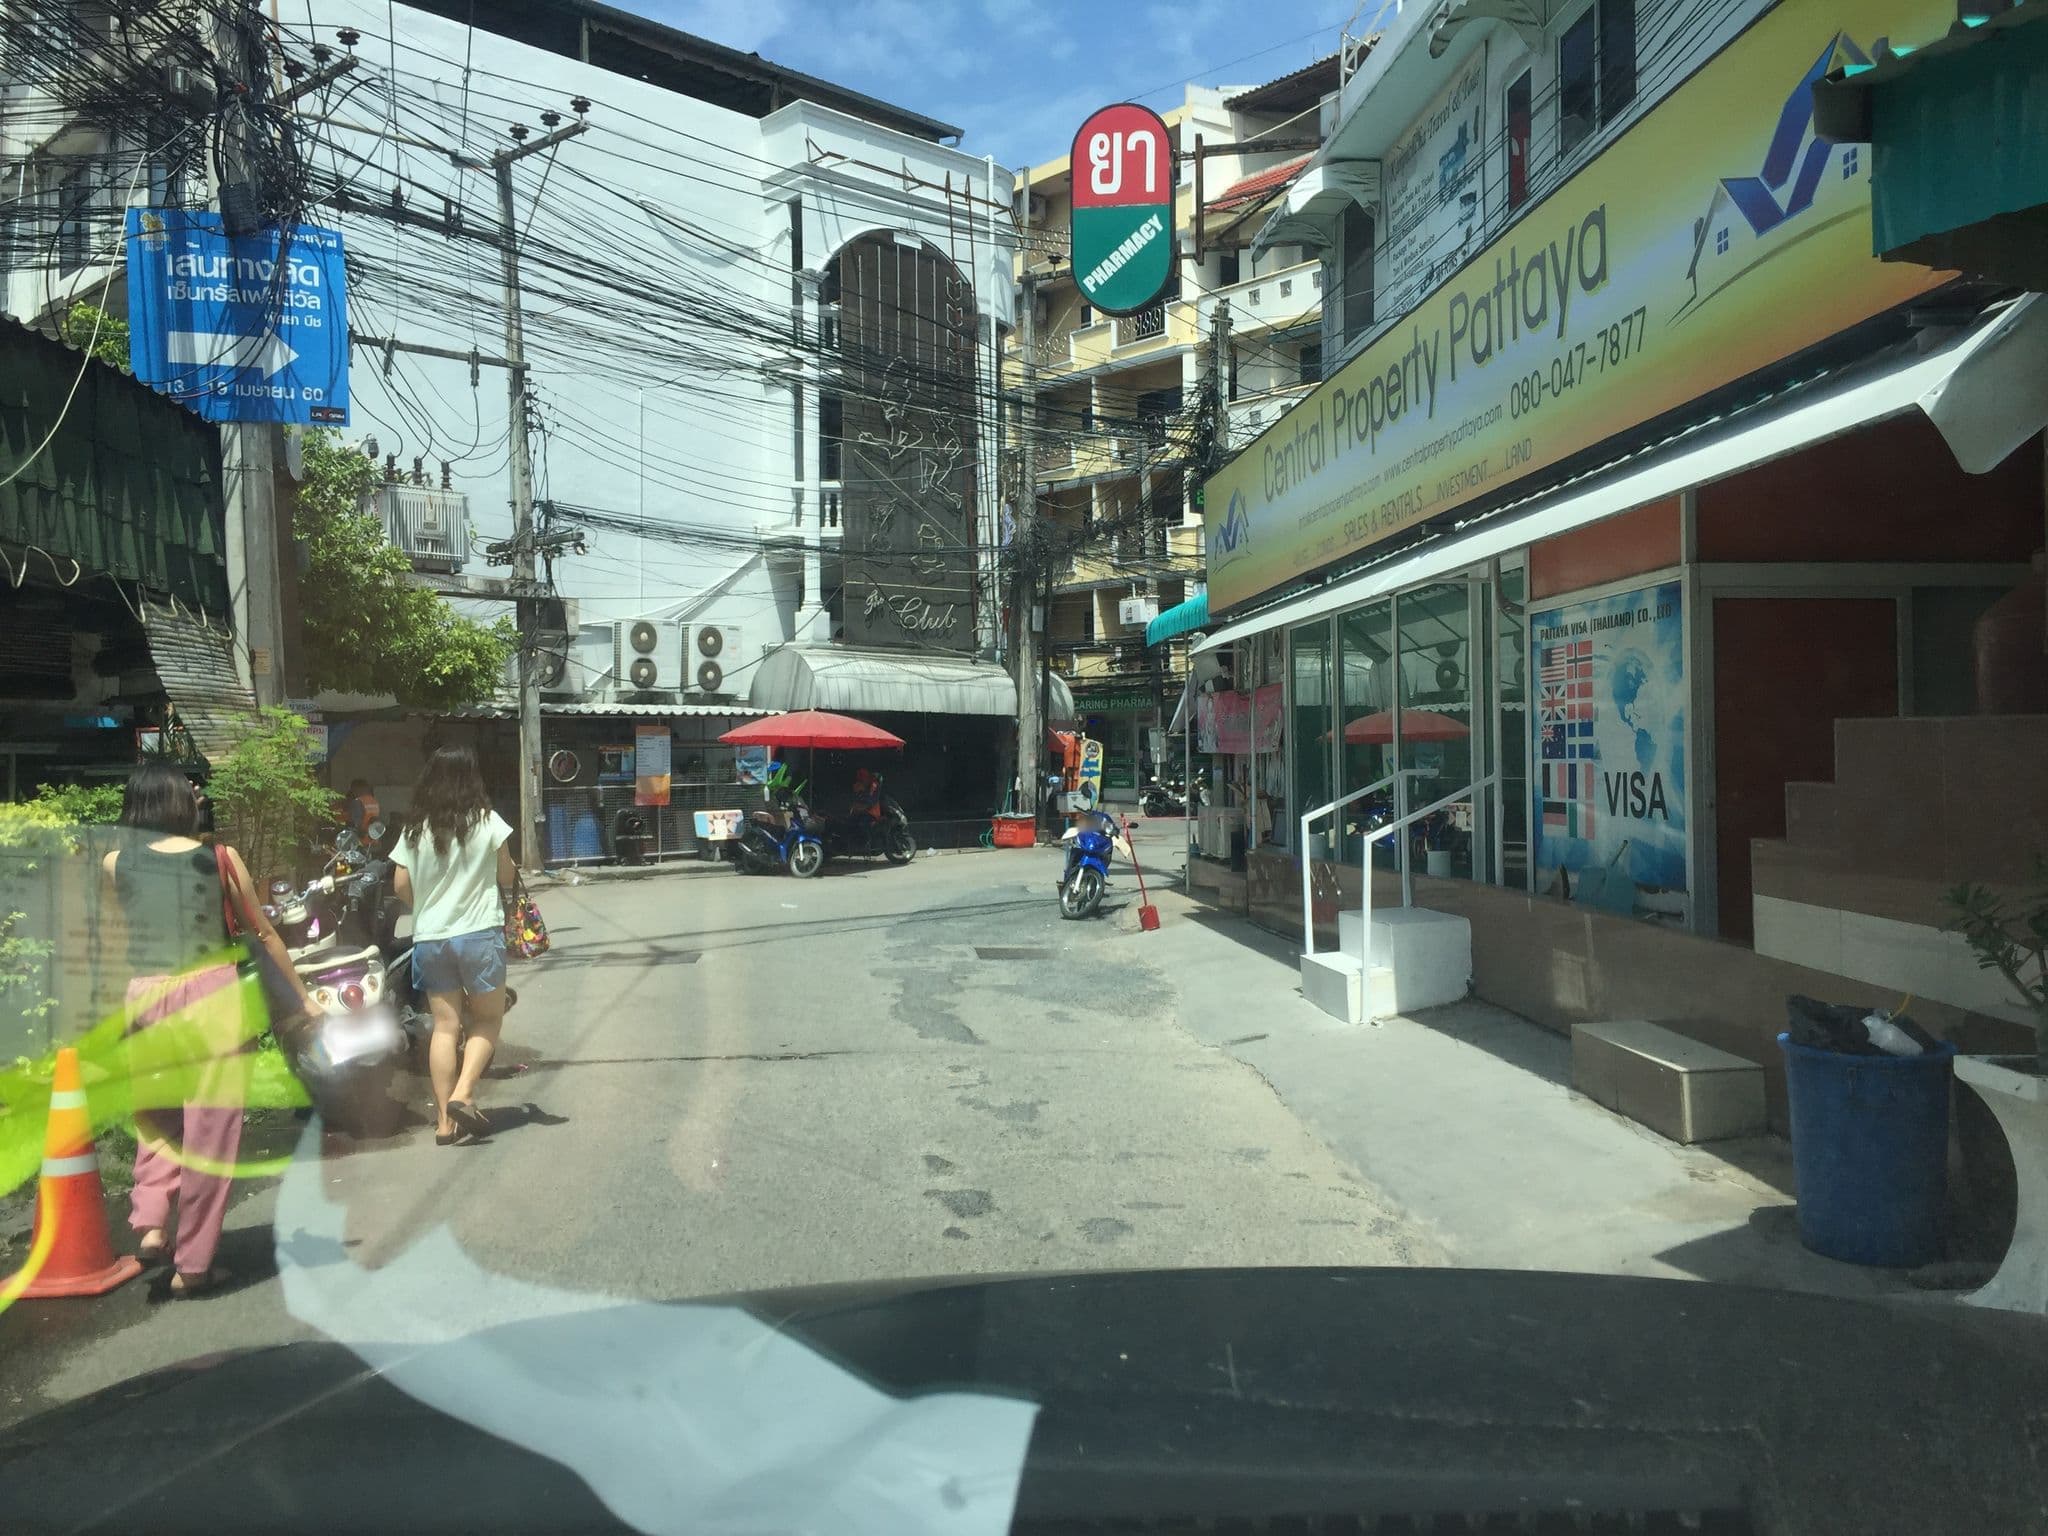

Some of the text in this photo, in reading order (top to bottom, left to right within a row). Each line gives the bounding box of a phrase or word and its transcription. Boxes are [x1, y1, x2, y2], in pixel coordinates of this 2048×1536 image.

[1089, 130, 1156, 195] ยา
[1082, 212, 1164, 294] PHARMACY
[1263, 412, 1325, 503] Central
[1333, 329, 1439, 454] Property
[1449, 203, 1608, 383] Pattaya
[1510, 306, 1647, 420] 080-047-7877
[302, 387, 324, 401] 60
[1344, 511, 1369, 546] SALES
[1540, 624, 1569, 641] PATTAYA
[1571, 621, 1588, 636] VISA
[1590, 611, 1635, 635] (THAILAND)
[1073, 697, 1153, 710] CARING PHARMA
[1604, 771, 1669, 821] VISA
